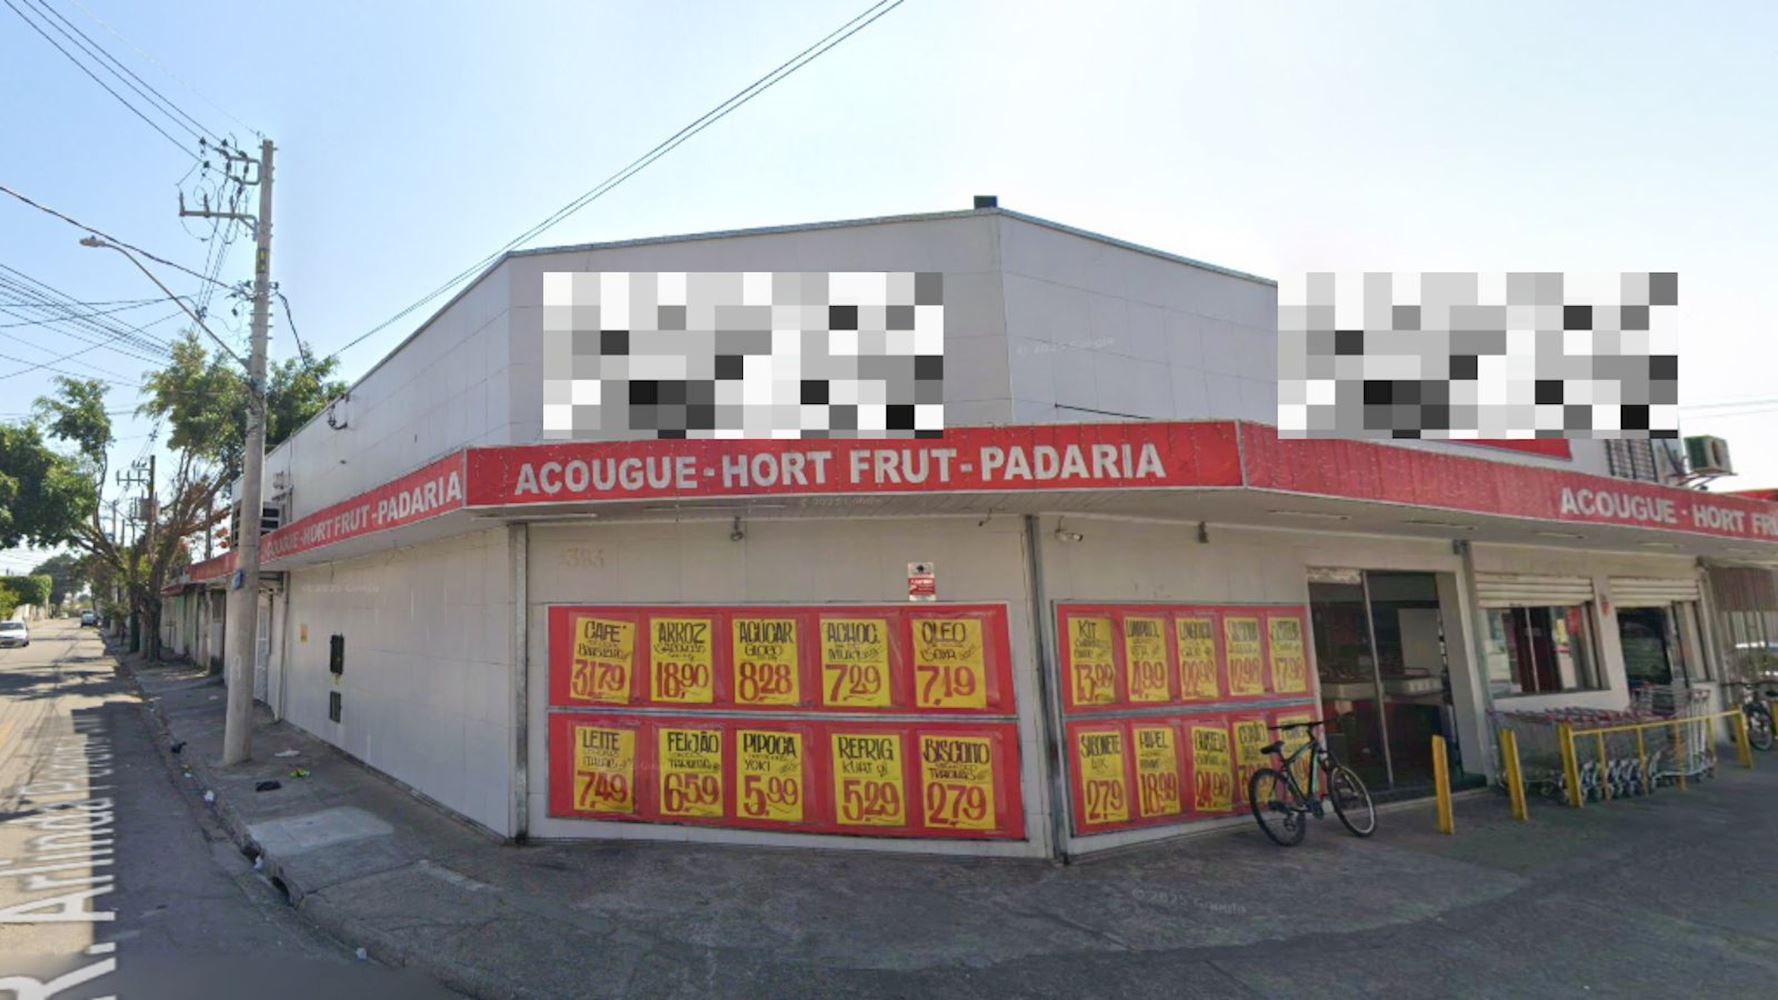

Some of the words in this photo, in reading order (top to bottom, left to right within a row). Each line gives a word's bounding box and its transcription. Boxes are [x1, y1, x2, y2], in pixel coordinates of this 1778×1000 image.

[850, 448, 957, 484] FRUT
[980, 442, 1167, 481] PADARIA
[335, 505, 370, 536] FRUT
[378, 471, 462, 525] PADARIA
[1560, 487, 1679, 525] ACOUGUE
[1692, 503, 1745, 533] HORT
[657, 621, 708, 645] ARROZ
[1078, 618, 1098, 639] KIT
[581, 729, 620, 751] LEITE
[666, 729, 720, 754] FEIJÃO
[742, 732, 798, 759] PIPOCA
[837, 736, 895, 762] REFRIG
